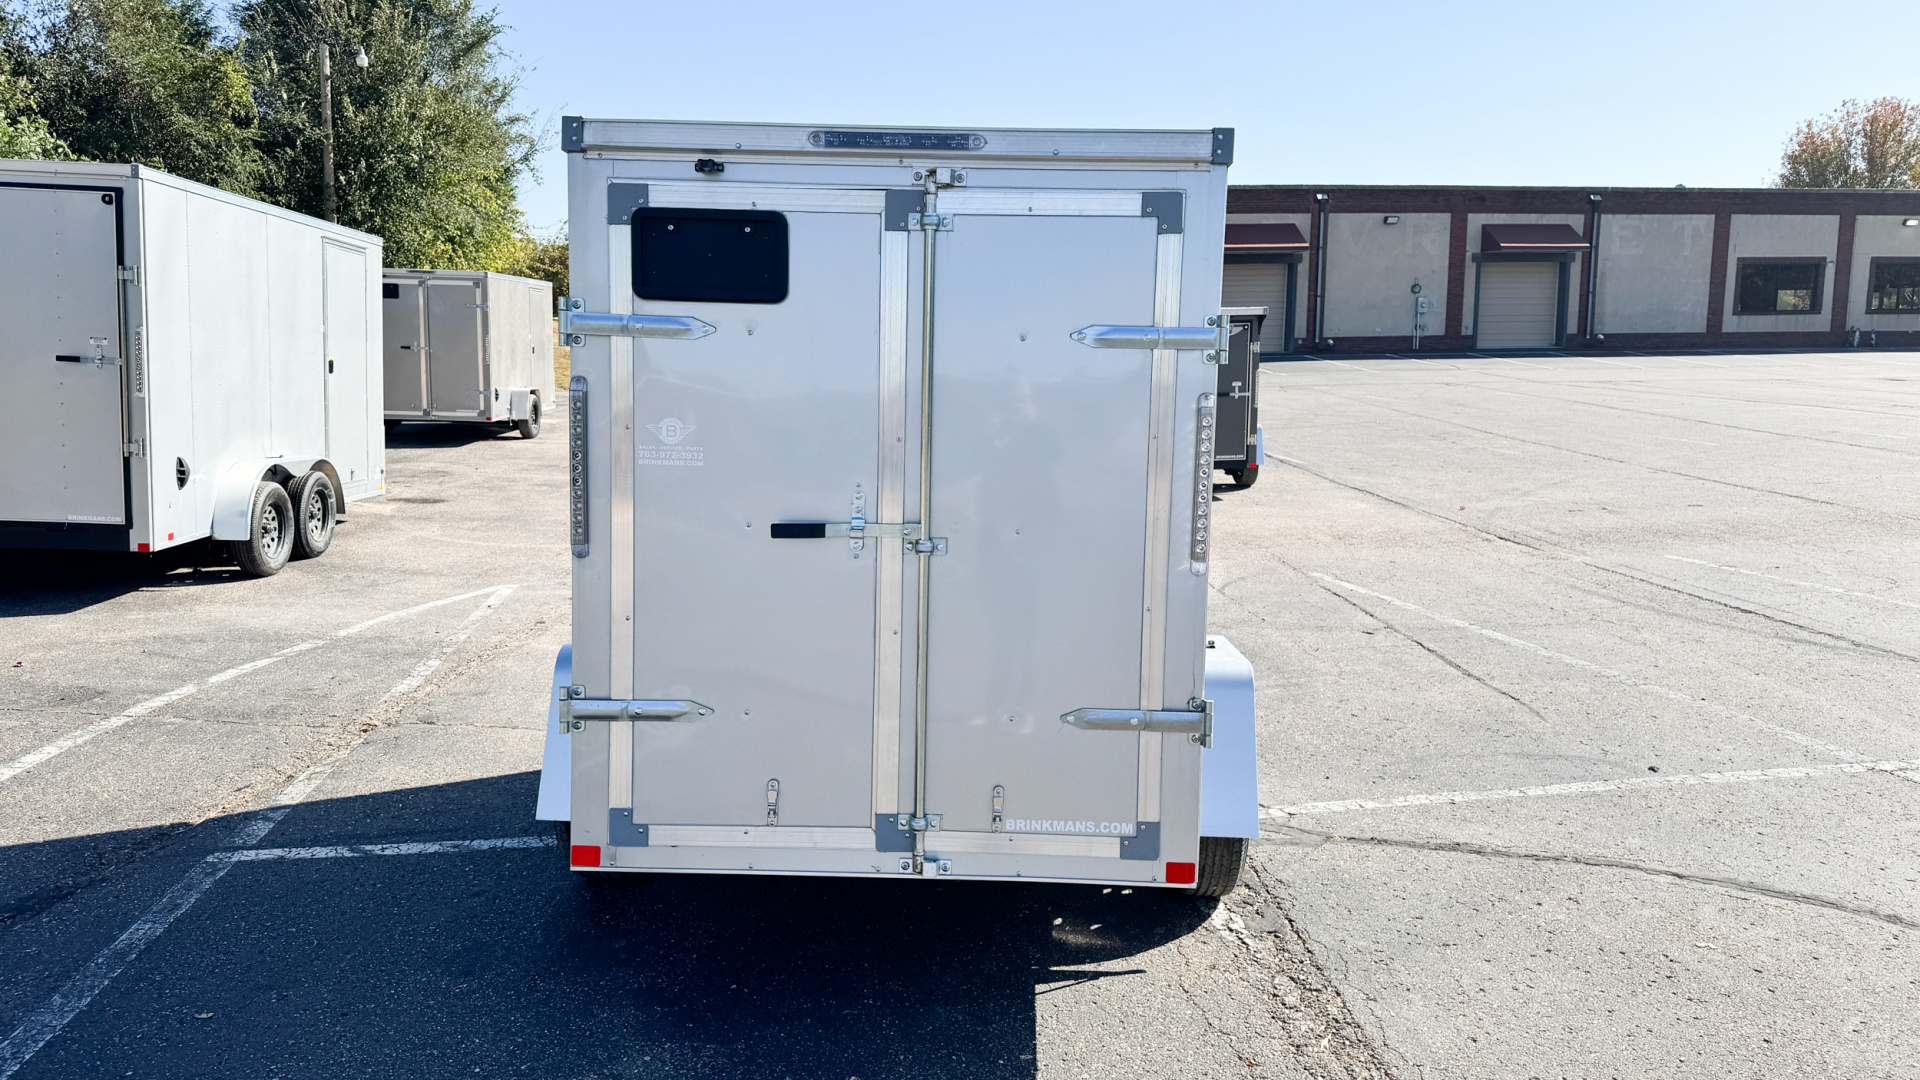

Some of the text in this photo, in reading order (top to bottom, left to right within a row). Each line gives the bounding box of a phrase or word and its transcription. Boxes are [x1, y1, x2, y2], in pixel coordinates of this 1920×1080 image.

[666, 425, 677, 437] B
[638, 450, 704, 459] 763-972-3932
[67, 514, 122, 522] BRINKMANS.COM
[1005, 819, 1133, 834] BRINKMANS.COM
